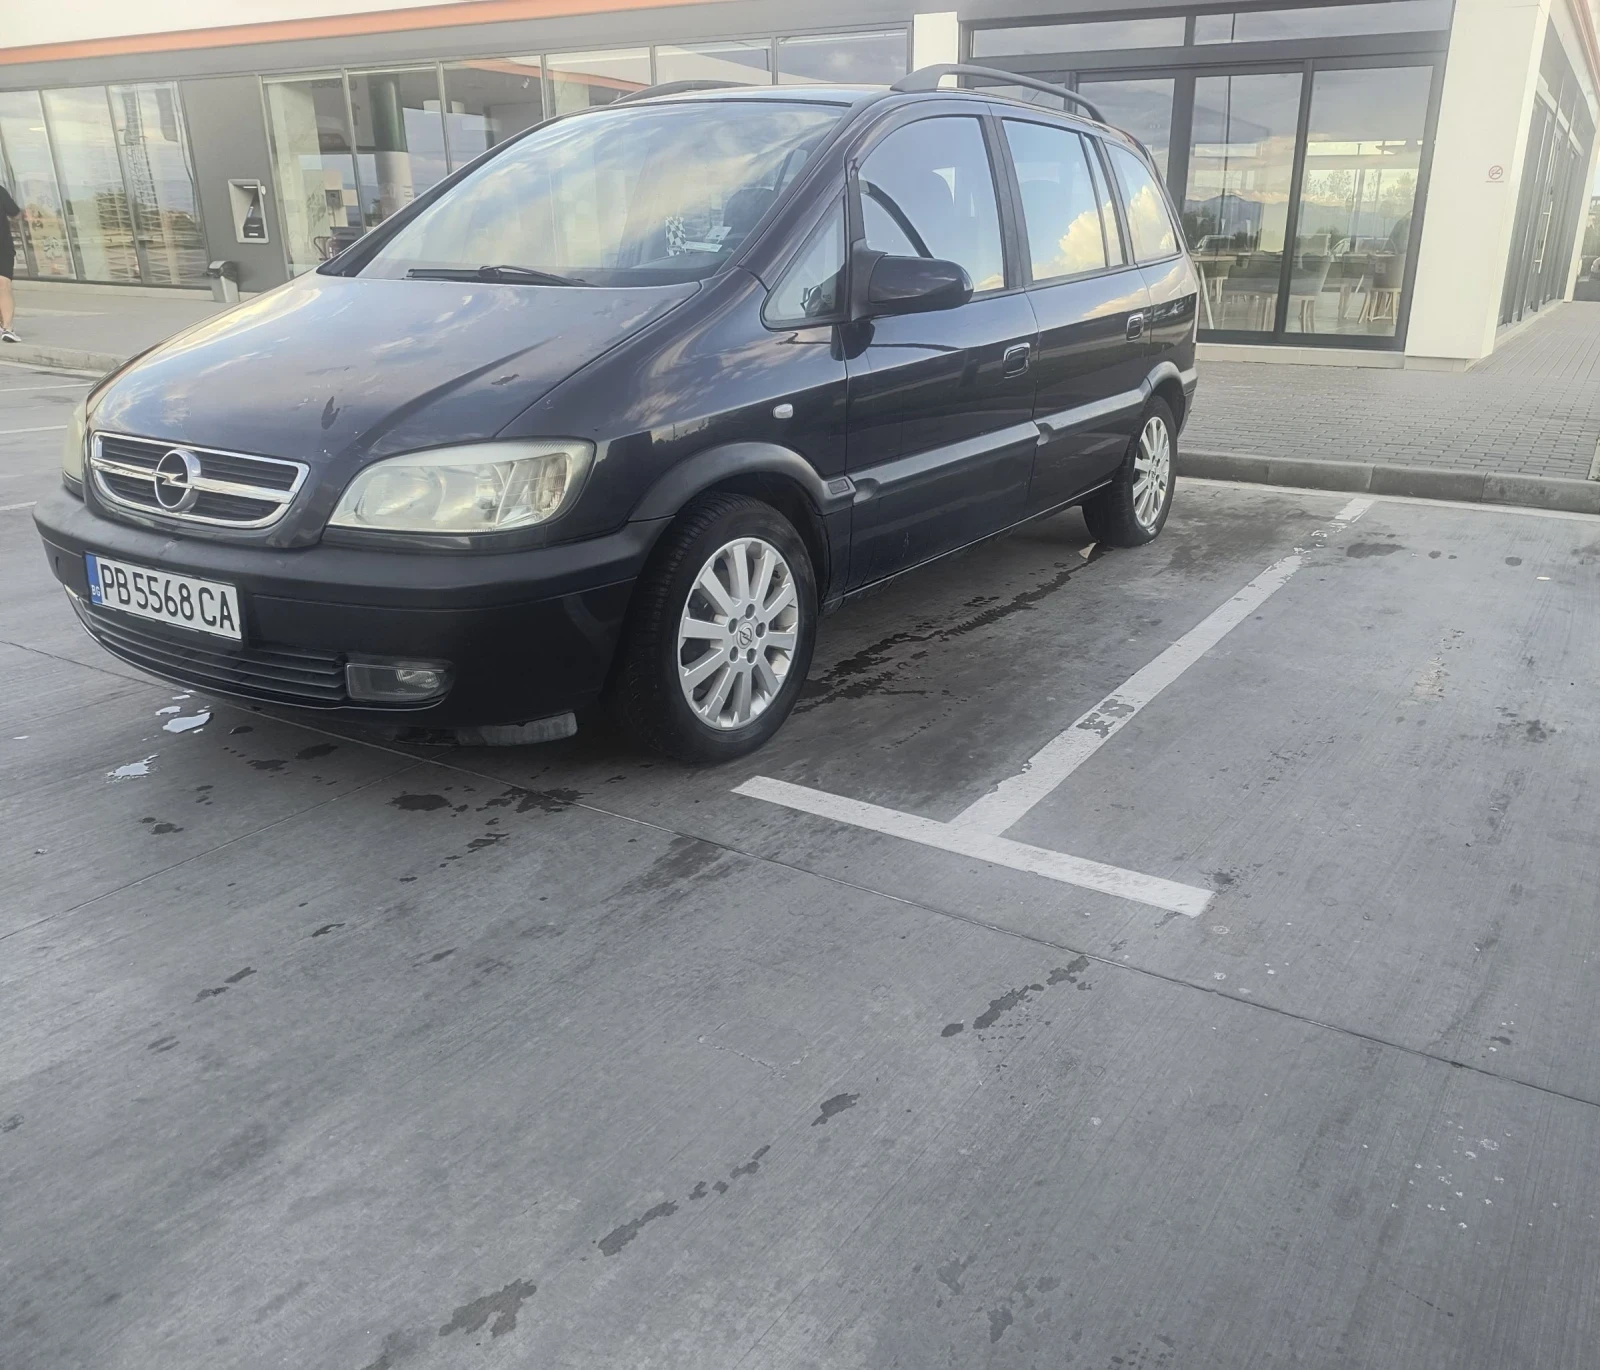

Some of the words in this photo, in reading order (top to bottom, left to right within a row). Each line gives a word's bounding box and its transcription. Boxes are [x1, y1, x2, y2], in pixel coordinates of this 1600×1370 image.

[91, 584, 101, 597] BG
[100, 563, 131, 605] PB
[132, 572, 194, 621] 5568
[199, 587, 235, 631] CA
